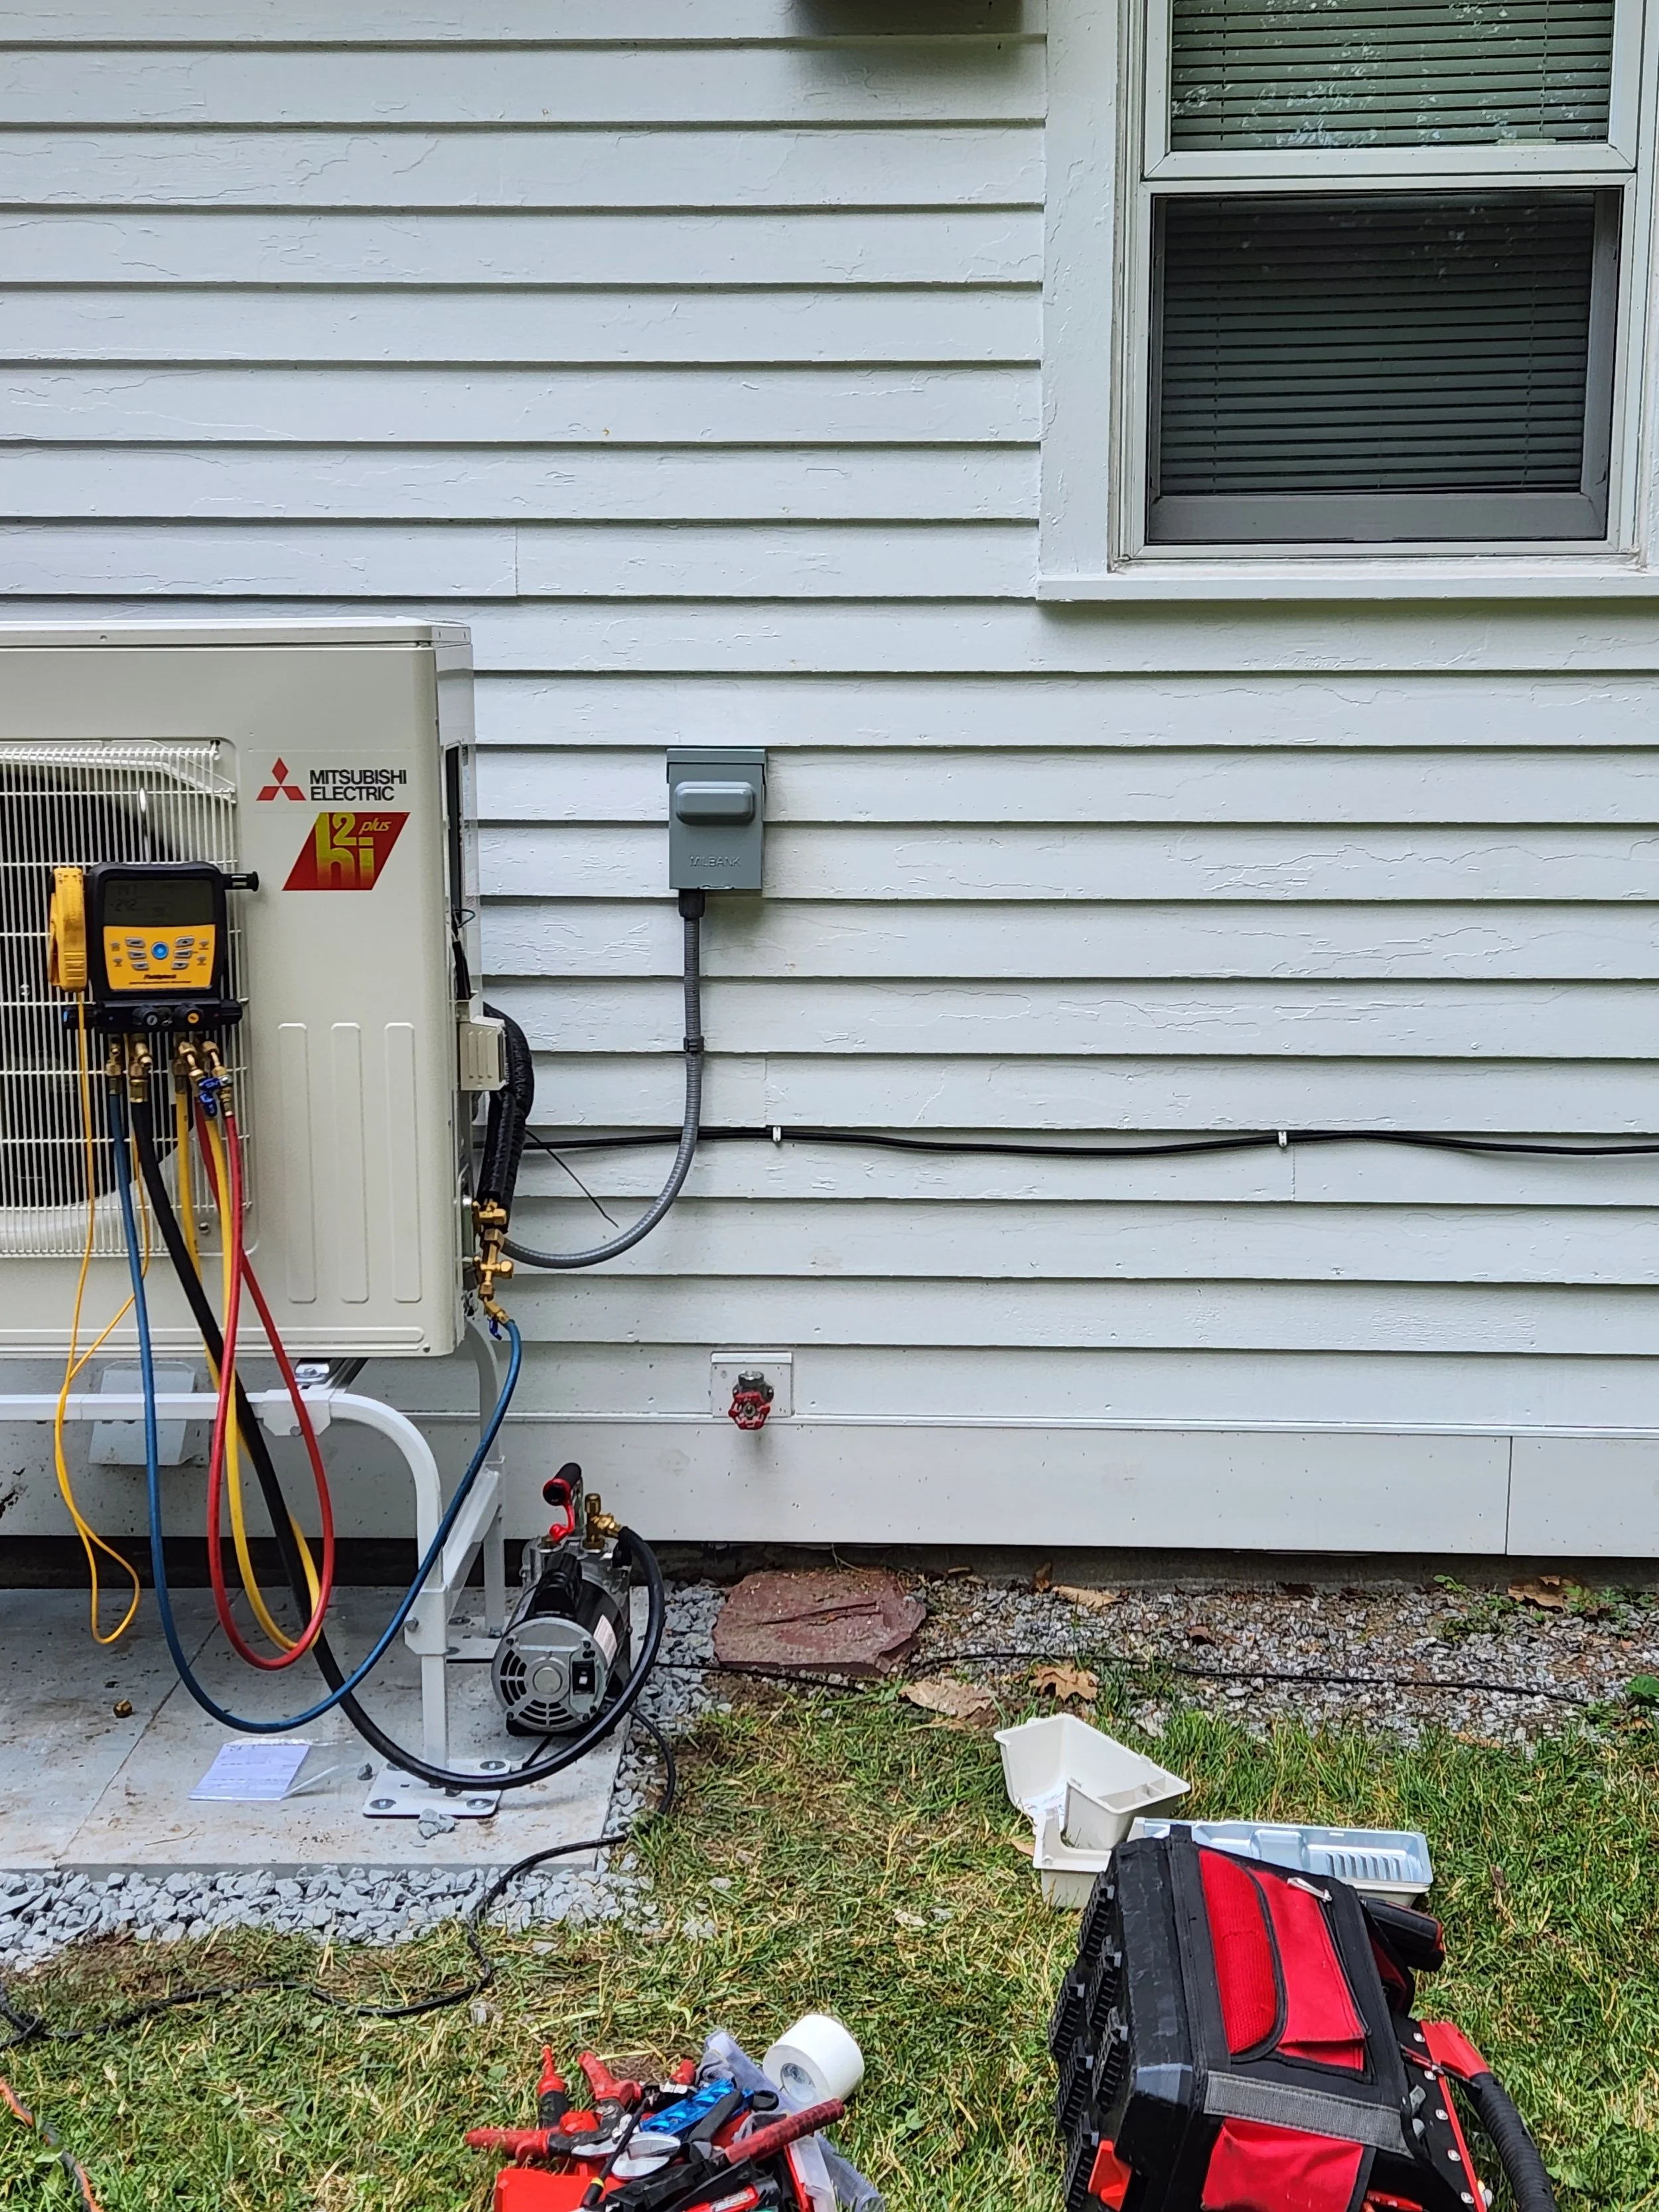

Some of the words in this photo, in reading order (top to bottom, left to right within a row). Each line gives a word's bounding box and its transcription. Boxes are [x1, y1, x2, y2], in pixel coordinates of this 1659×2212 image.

[310, 769, 407, 784] MITSUBISHI
[311, 786, 395, 801] ELECTRIC
[358, 818, 392, 835] plus
